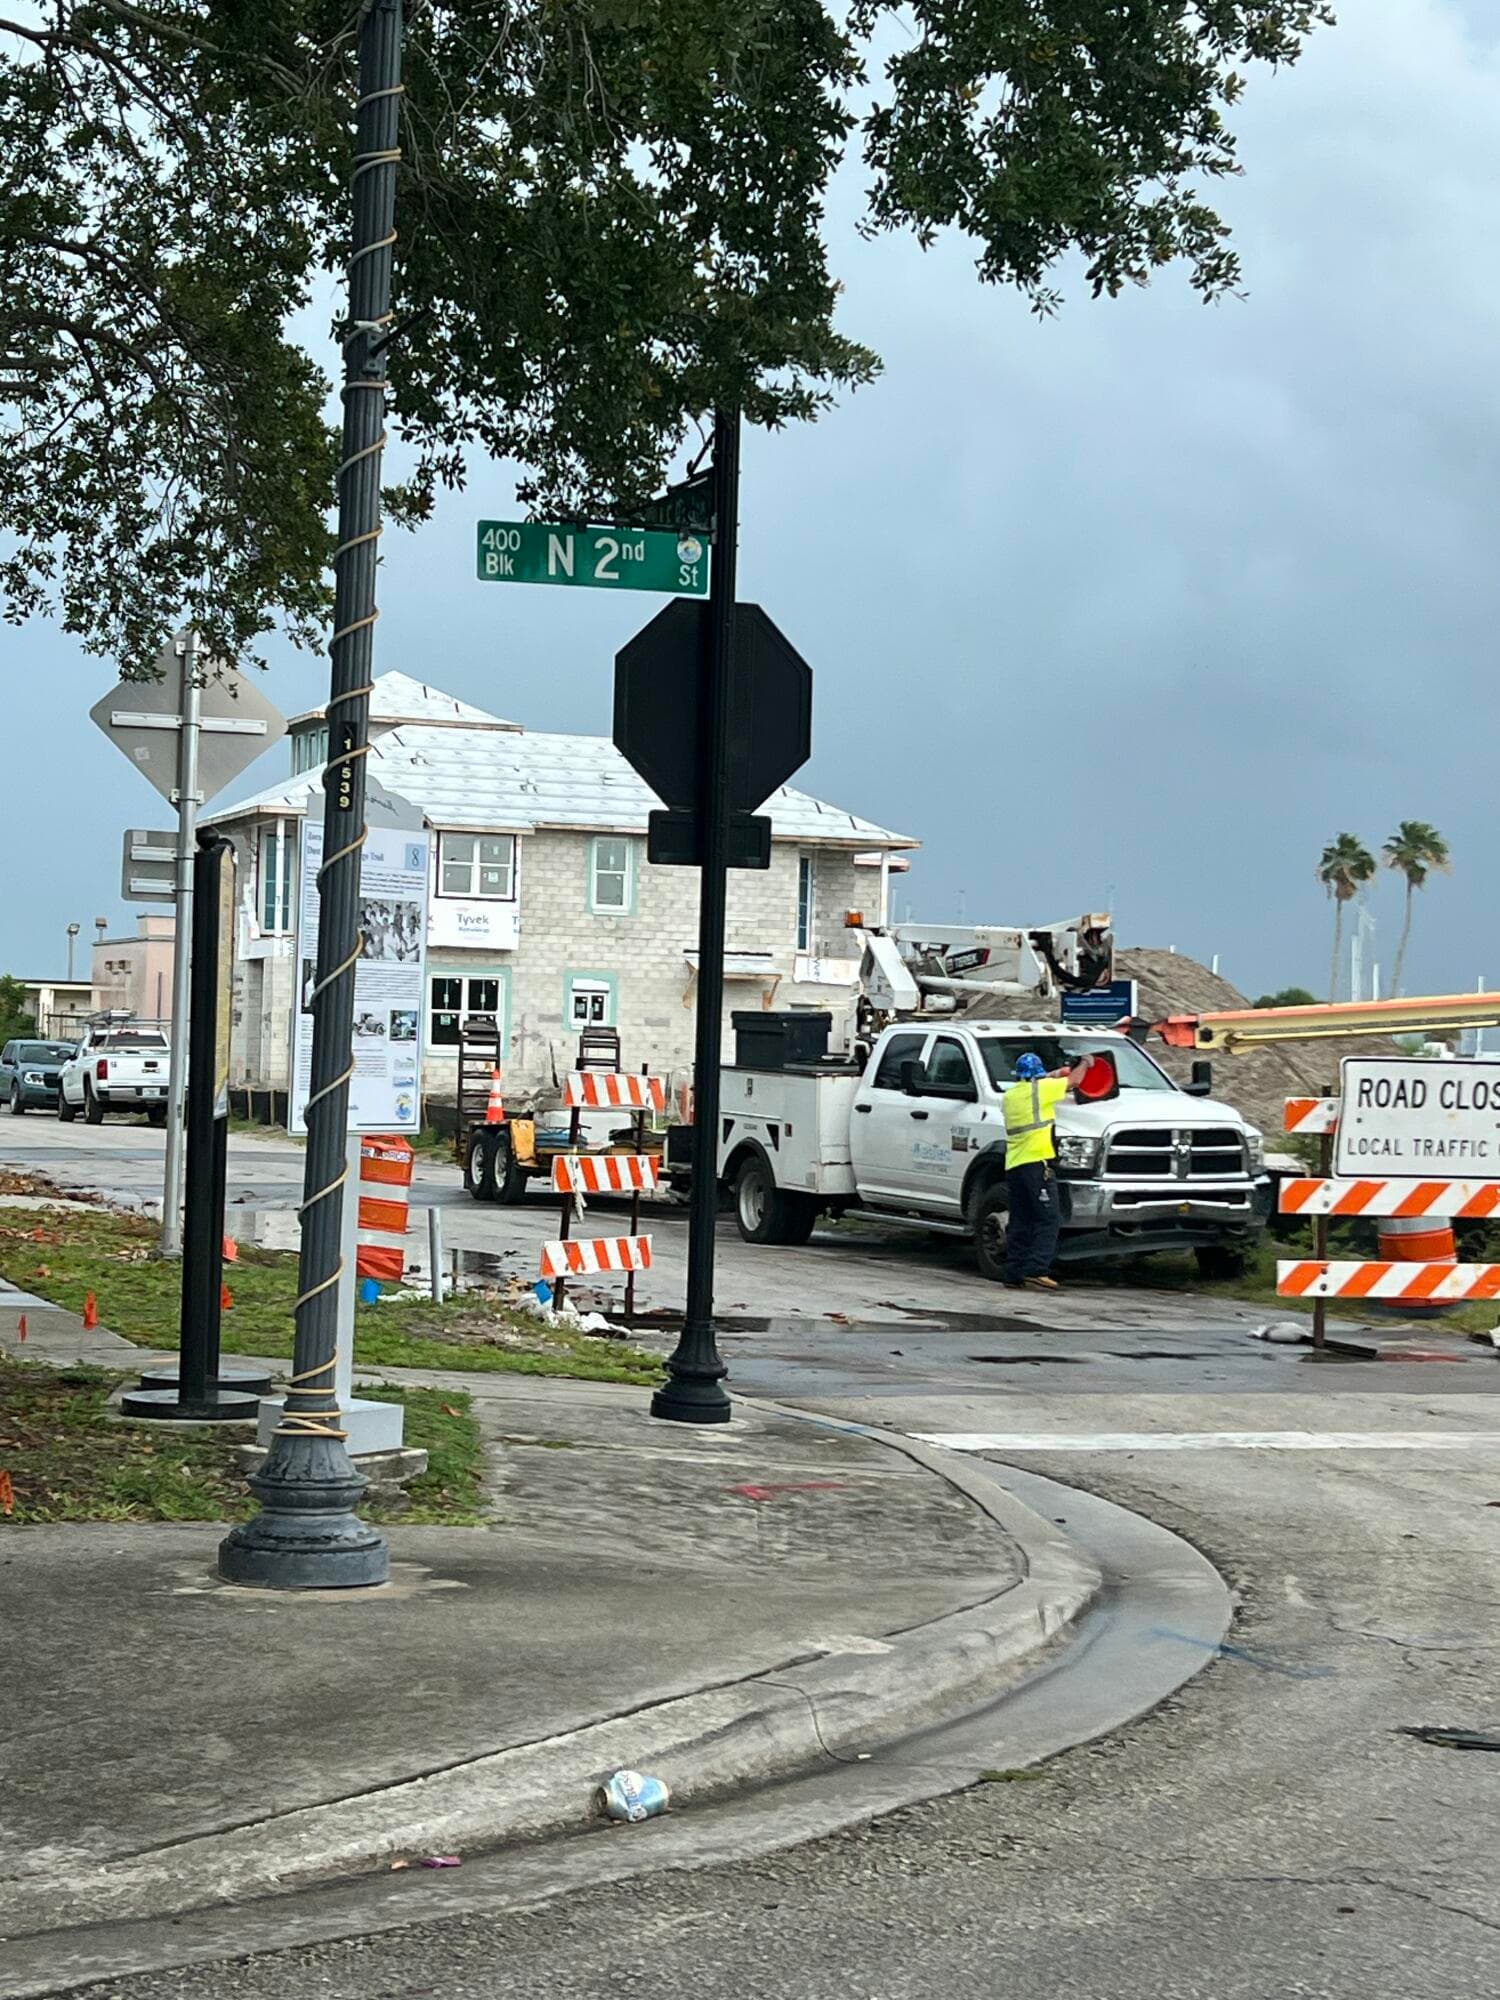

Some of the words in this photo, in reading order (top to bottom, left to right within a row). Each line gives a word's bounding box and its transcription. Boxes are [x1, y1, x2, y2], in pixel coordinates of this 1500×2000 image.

[481, 528, 521, 551] 400
[485, 552, 514, 576] Blk
[548, 533, 575, 577] N
[594, 536, 645, 580] 2nd
[678, 564, 698, 587] St
[339, 738, 352, 808] 1539
[457, 913, 489, 926] Tyvek
[1358, 1078, 1427, 1109] ROAD
[1347, 1137, 1403, 1156] LOCAL
[1413, 1138, 1487, 1158] TRAFFIC
